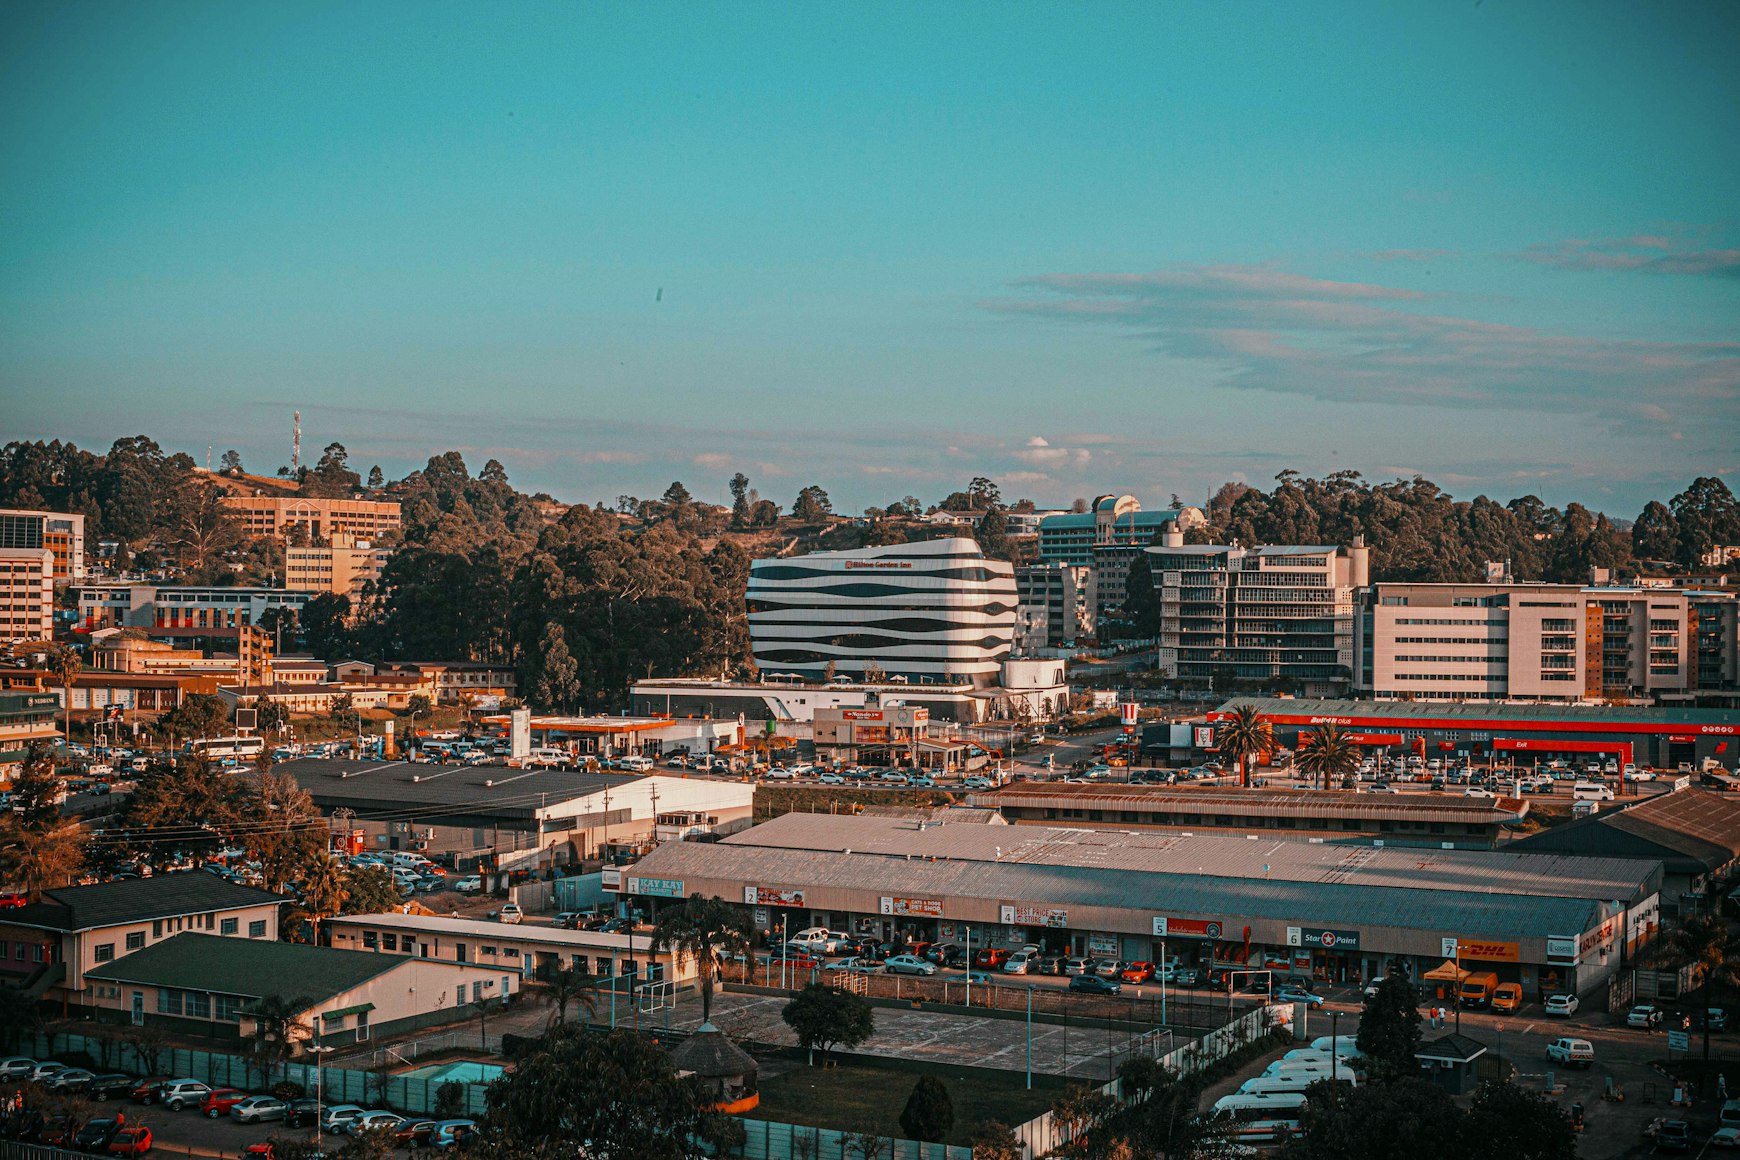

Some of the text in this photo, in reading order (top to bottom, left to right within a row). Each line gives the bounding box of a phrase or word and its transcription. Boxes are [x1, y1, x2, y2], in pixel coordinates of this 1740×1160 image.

[631, 884, 636, 892] 1
[640, 878, 660, 888] KAY
[662, 880, 683, 890] KAY
[748, 894, 754, 902] 2
[884, 904, 890, 913] 3
[1016, 907, 1030, 916] BEST
[1032, 908, 1048, 917] PRICE
[1005, 913, 1010, 922] 4
[1157, 924, 1162, 934] 5
[1291, 934, 1298, 944] 6
[1305, 934, 1356, 944] Star Paint
[1446, 944, 1452, 956] 7
[1470, 944, 1506, 956] DHL
